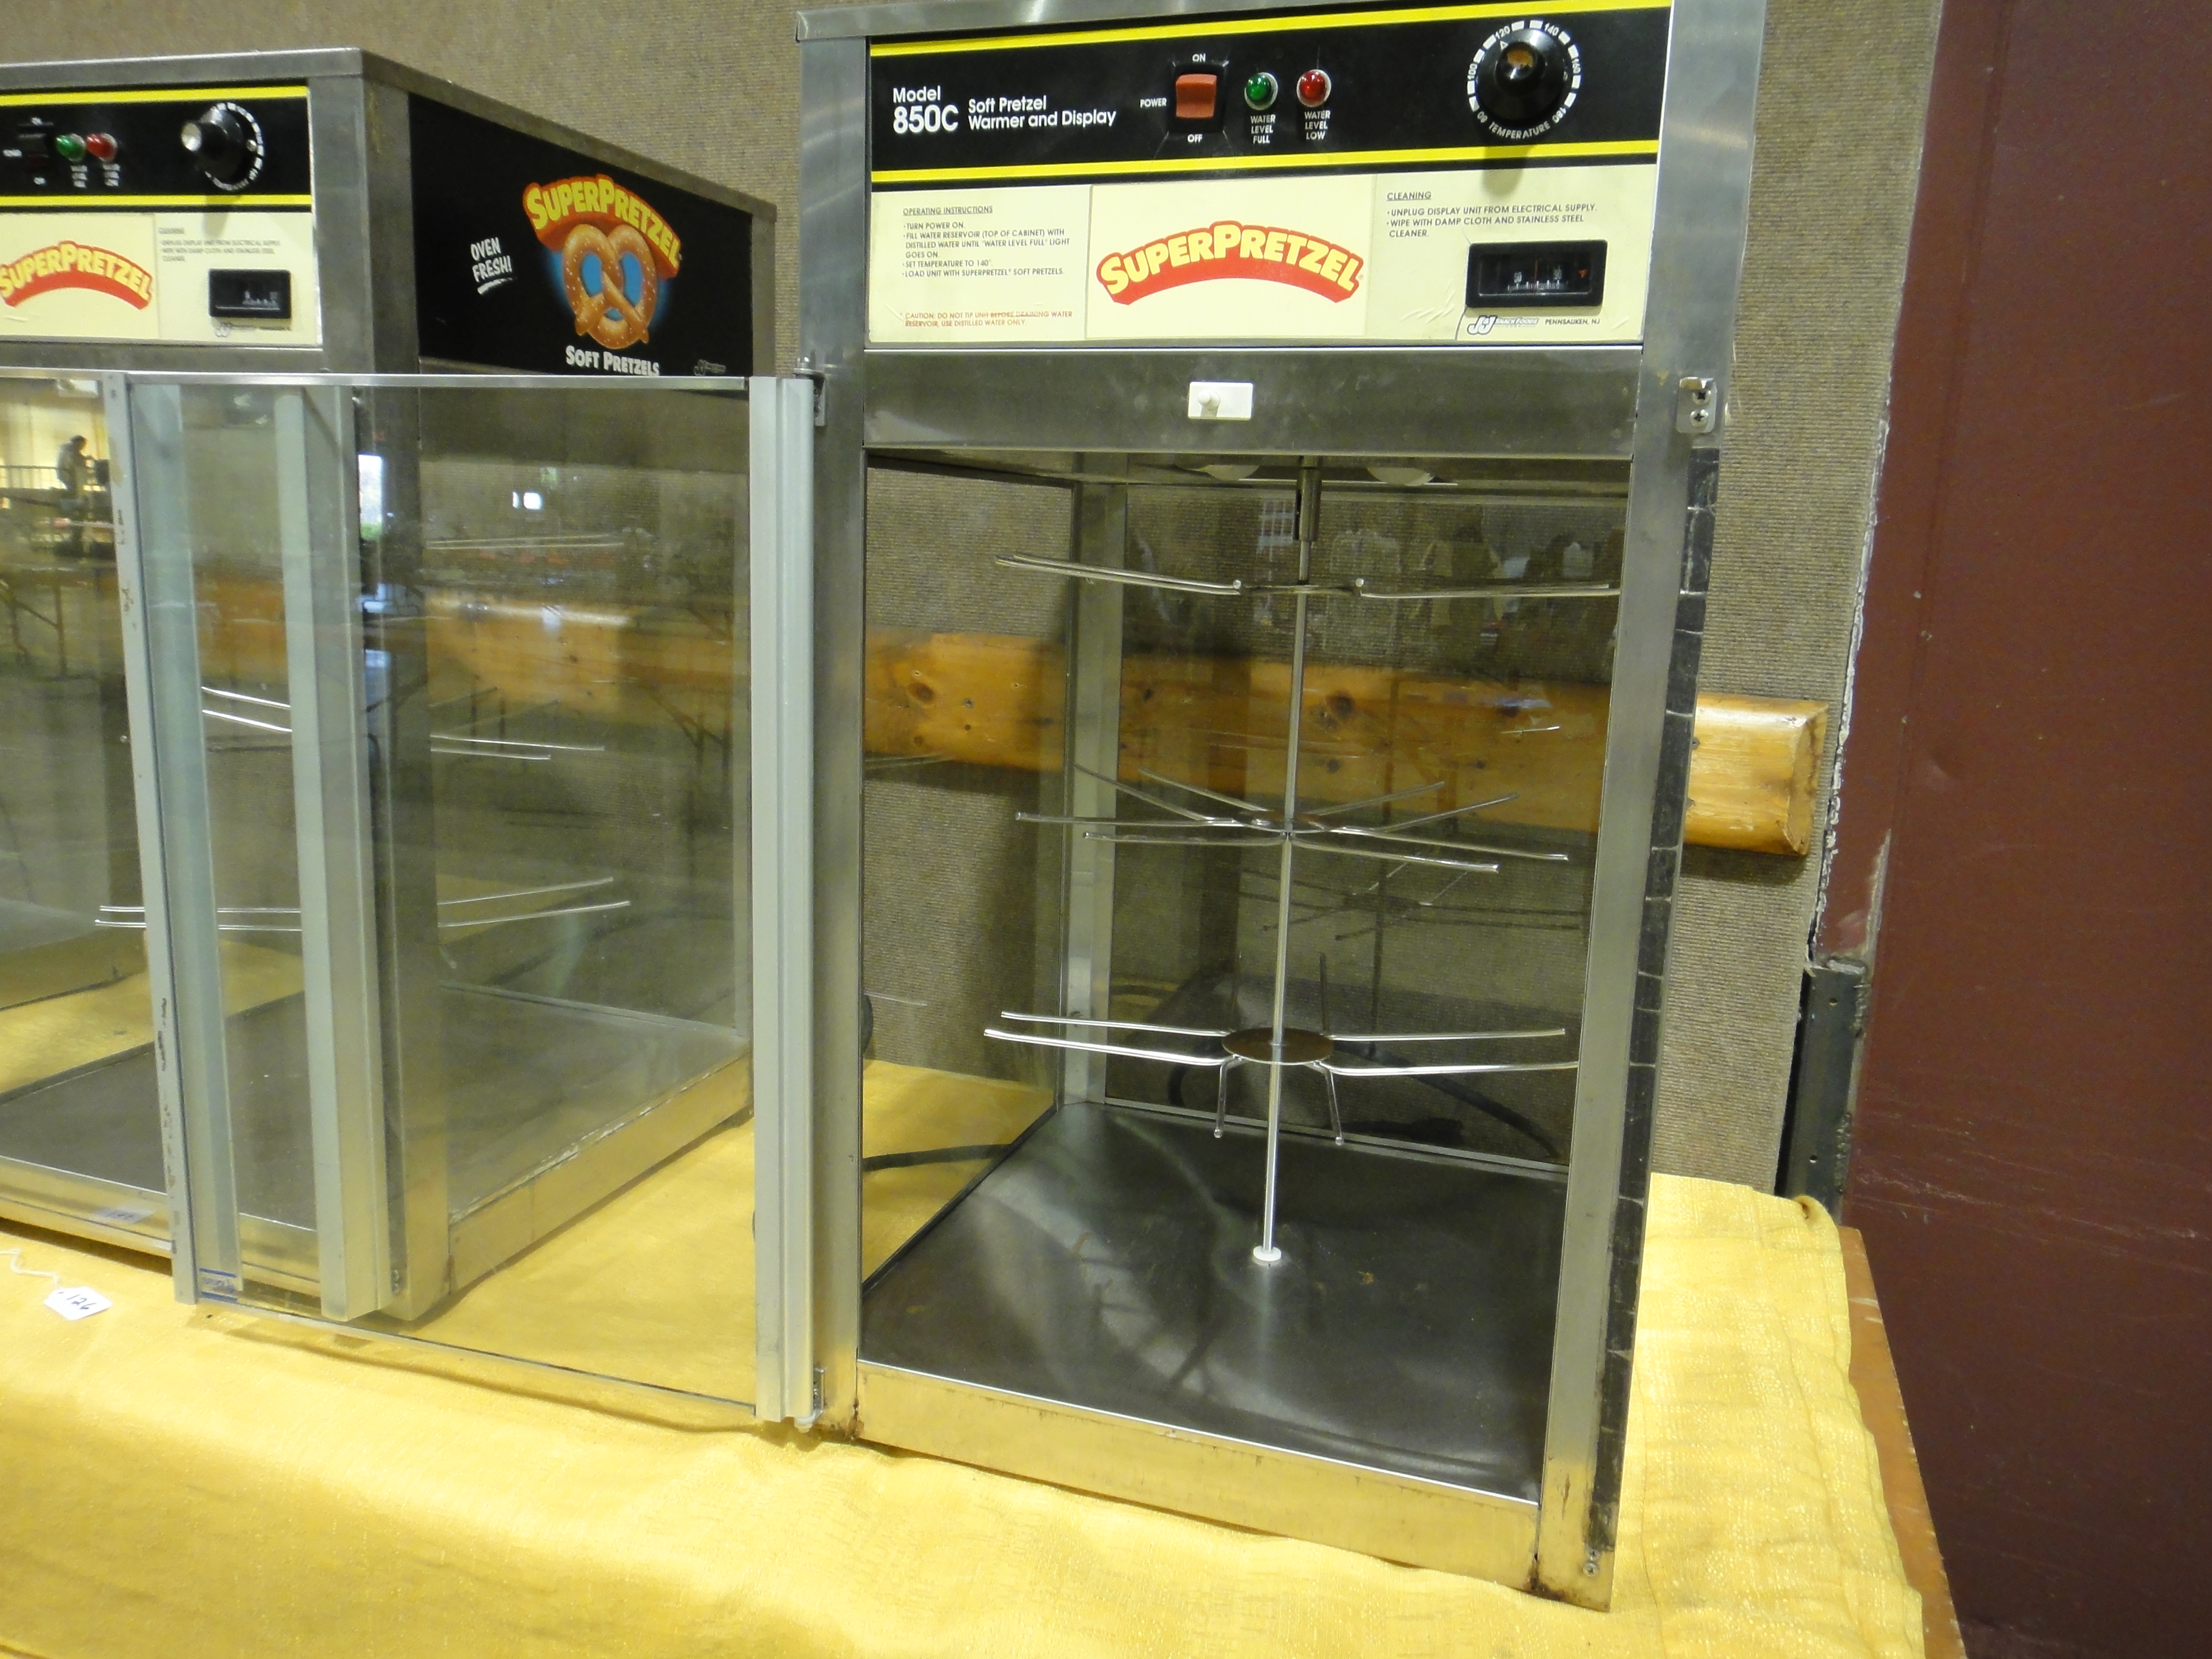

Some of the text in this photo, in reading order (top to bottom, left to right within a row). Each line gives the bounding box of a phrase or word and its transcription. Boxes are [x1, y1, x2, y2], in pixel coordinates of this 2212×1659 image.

[1495, 25, 1510, 39] 120
[1544, 22, 1559, 36] 140
[1192, 53, 1206, 62] ON
[1467, 63, 1478, 79] 100
[893, 86, 940, 102] Model
[968, 95, 1047, 113] Soft Pretzel
[1140, 98, 1167, 108] POWER
[893, 105, 959, 134] 850C
[968, 109, 1116, 130] Warmer and Display
[1250, 114, 1276, 124] WATER
[1304, 110, 1331, 119] WATER
[1552, 107, 1566, 124] 180
[1251, 125, 1273, 134] LEVEL
[1305, 121, 1328, 130] LEVEL
[1489, 121, 1550, 139] TEMPERATURE
[1187, 134, 1202, 143] OFF
[1253, 135, 1270, 144] FULL
[1306, 131, 1326, 140] LOW
[1386, 191, 1432, 201] CLEANING
[903, 206, 993, 215] OPERATING INSTRUCTIONS
[1391, 208, 1425, 216] UNPLUG
[1427, 207, 1461, 216] DISPLAY
[1463, 206, 1483, 215] UNIT
[1484, 205, 1509, 214] FROM
[1512, 204, 1563, 213] ELECTRICAL
[526, 178, 681, 269] SUPERPRETZEL
[1435, 217, 1461, 226] DAMP
[1464, 216, 1492, 225] CLOTH
[1495, 216, 1514, 224] AND
[1517, 215, 1560, 224] STAINLESS
[1561, 214, 1584, 223] STEEL
[982, 230, 998, 238] (TOP
[1012, 229, 1045, 237] CABINET)
[471, 236, 501, 261] OVEN
[1099, 223, 1361, 296] SUPERPRETZEL
[472, 255, 512, 283] FRESH!
[565, 344, 660, 376] SOFT PRETZELS
